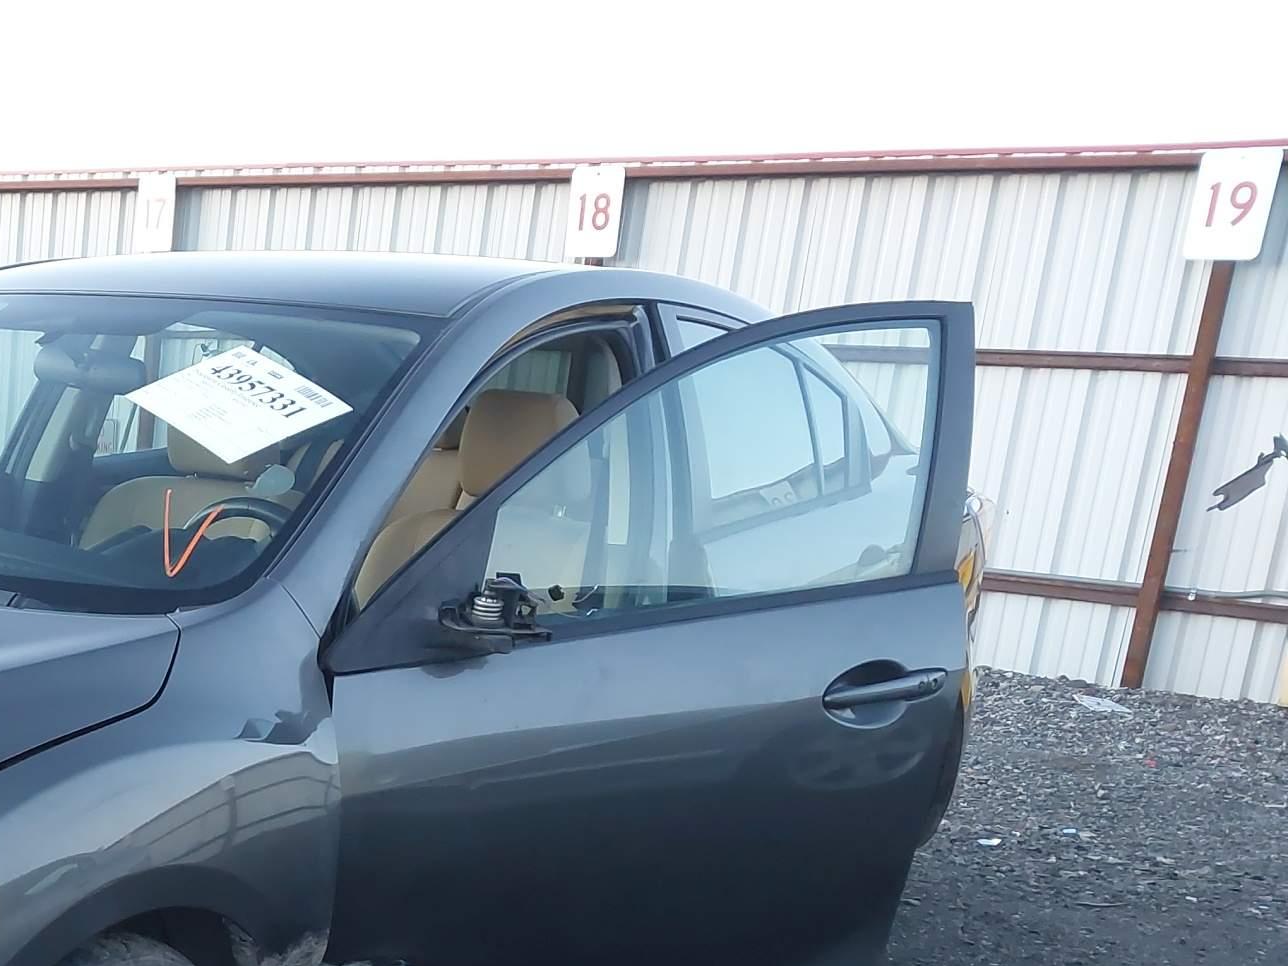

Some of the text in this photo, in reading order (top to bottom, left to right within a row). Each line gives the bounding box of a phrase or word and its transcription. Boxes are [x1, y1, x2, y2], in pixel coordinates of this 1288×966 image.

[144, 197, 169, 230] 17
[578, 193, 611, 231] 18
[1203, 180, 1258, 228] 19
[210, 365, 307, 418] 43957331
